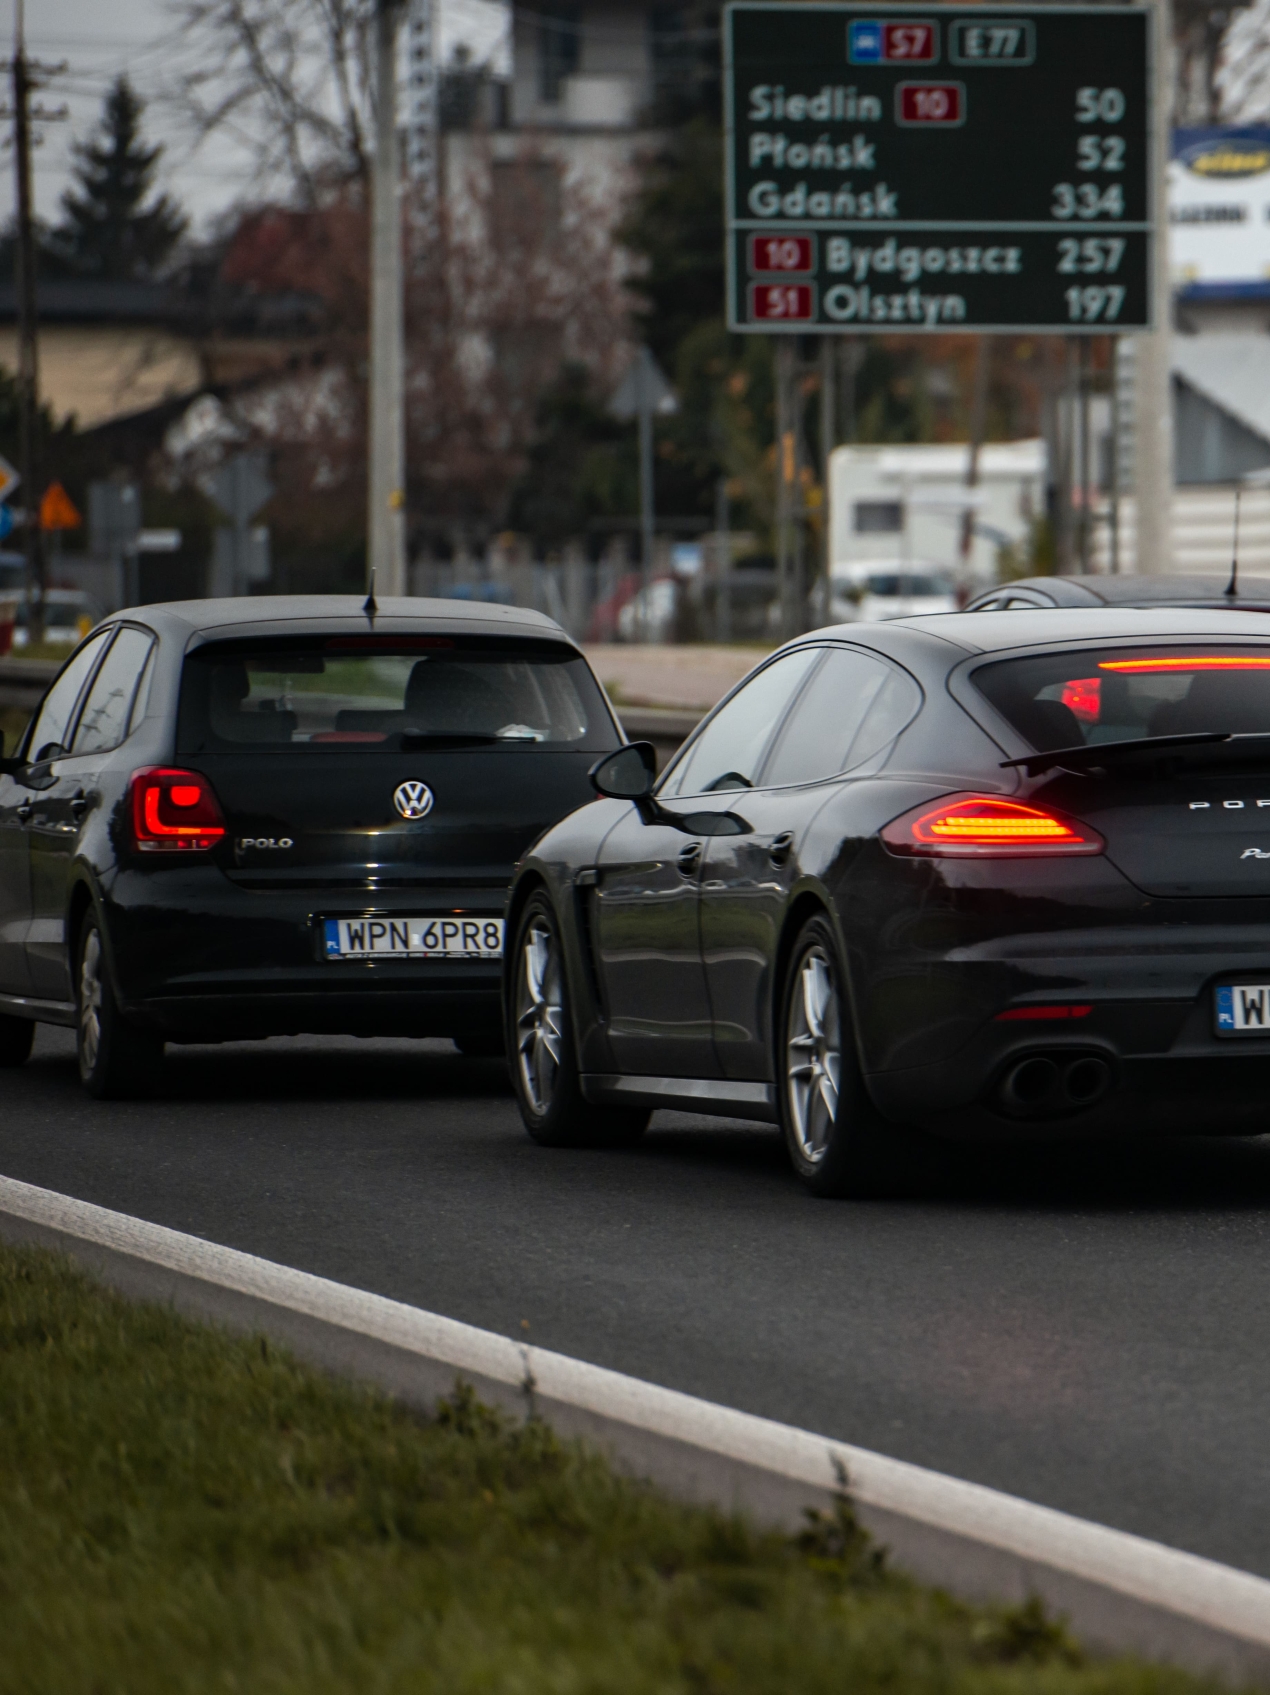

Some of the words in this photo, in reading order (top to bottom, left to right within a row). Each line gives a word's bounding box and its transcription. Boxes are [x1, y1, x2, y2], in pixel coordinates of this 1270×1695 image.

[889, 27, 928, 57] S7
[748, 84, 883, 122] Siedlin
[912, 91, 950, 118] 10
[1075, 87, 1126, 123] 50
[748, 132, 876, 170] Płońsk
[1076, 136, 1126, 172] 52
[748, 180, 899, 219] Gdańsk
[1050, 183, 1125, 219] 334
[764, 240, 800, 268] 10
[825, 236, 1023, 282] Bydgoszcz
[1056, 238, 1127, 274] 257
[823, 285, 967, 326] Olsztyn
[1065, 286, 1127, 322] 197
[241, 838, 293, 849] POLO
[327, 940, 339, 949] PL
[346, 921, 409, 951] WPN
[422, 921, 501, 950] 6PR8
[1219, 1013, 1233, 1023] PL
